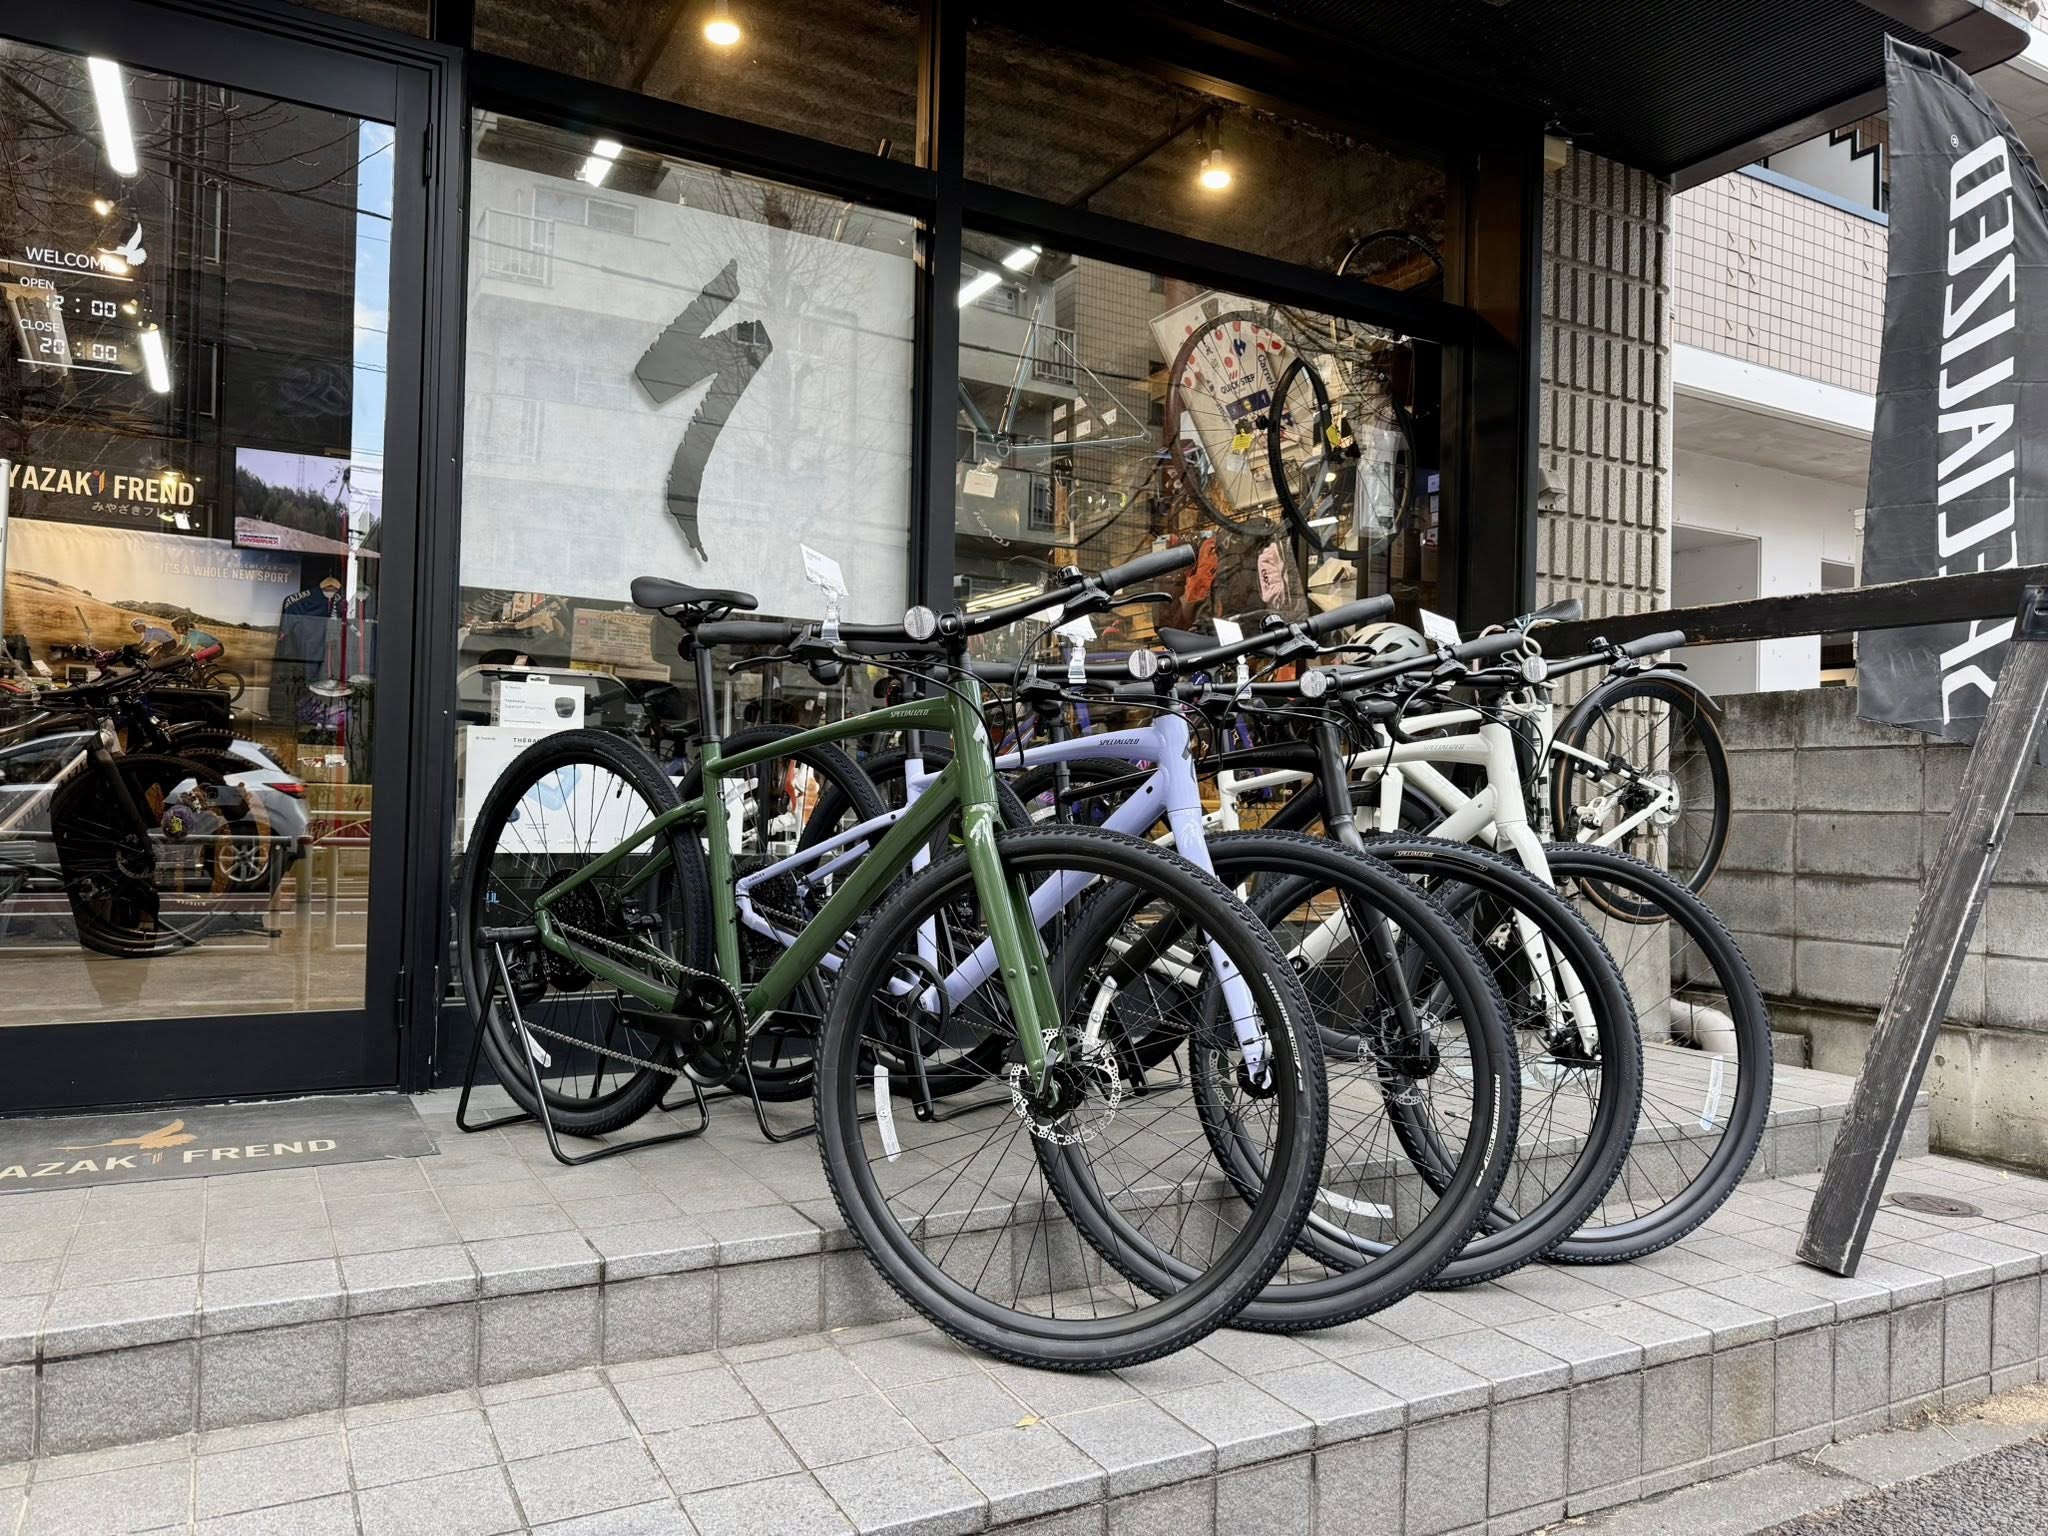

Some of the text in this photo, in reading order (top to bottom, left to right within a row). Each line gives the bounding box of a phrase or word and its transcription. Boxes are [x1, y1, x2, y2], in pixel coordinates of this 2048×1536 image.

[25, 246, 116, 272] WELCOM
[20, 276, 55, 290] OPEN
[20, 318, 61, 332] CLOSE
[114, 475, 195, 507] FREND
[160, 563, 290, 584] IT'S A WHOLE NEW SPORT
[890, 708, 930, 718] SPECIALIZED
[1099, 738, 1140, 746] SPECIALIZED
[182, 1139, 337, 1164] FREND
